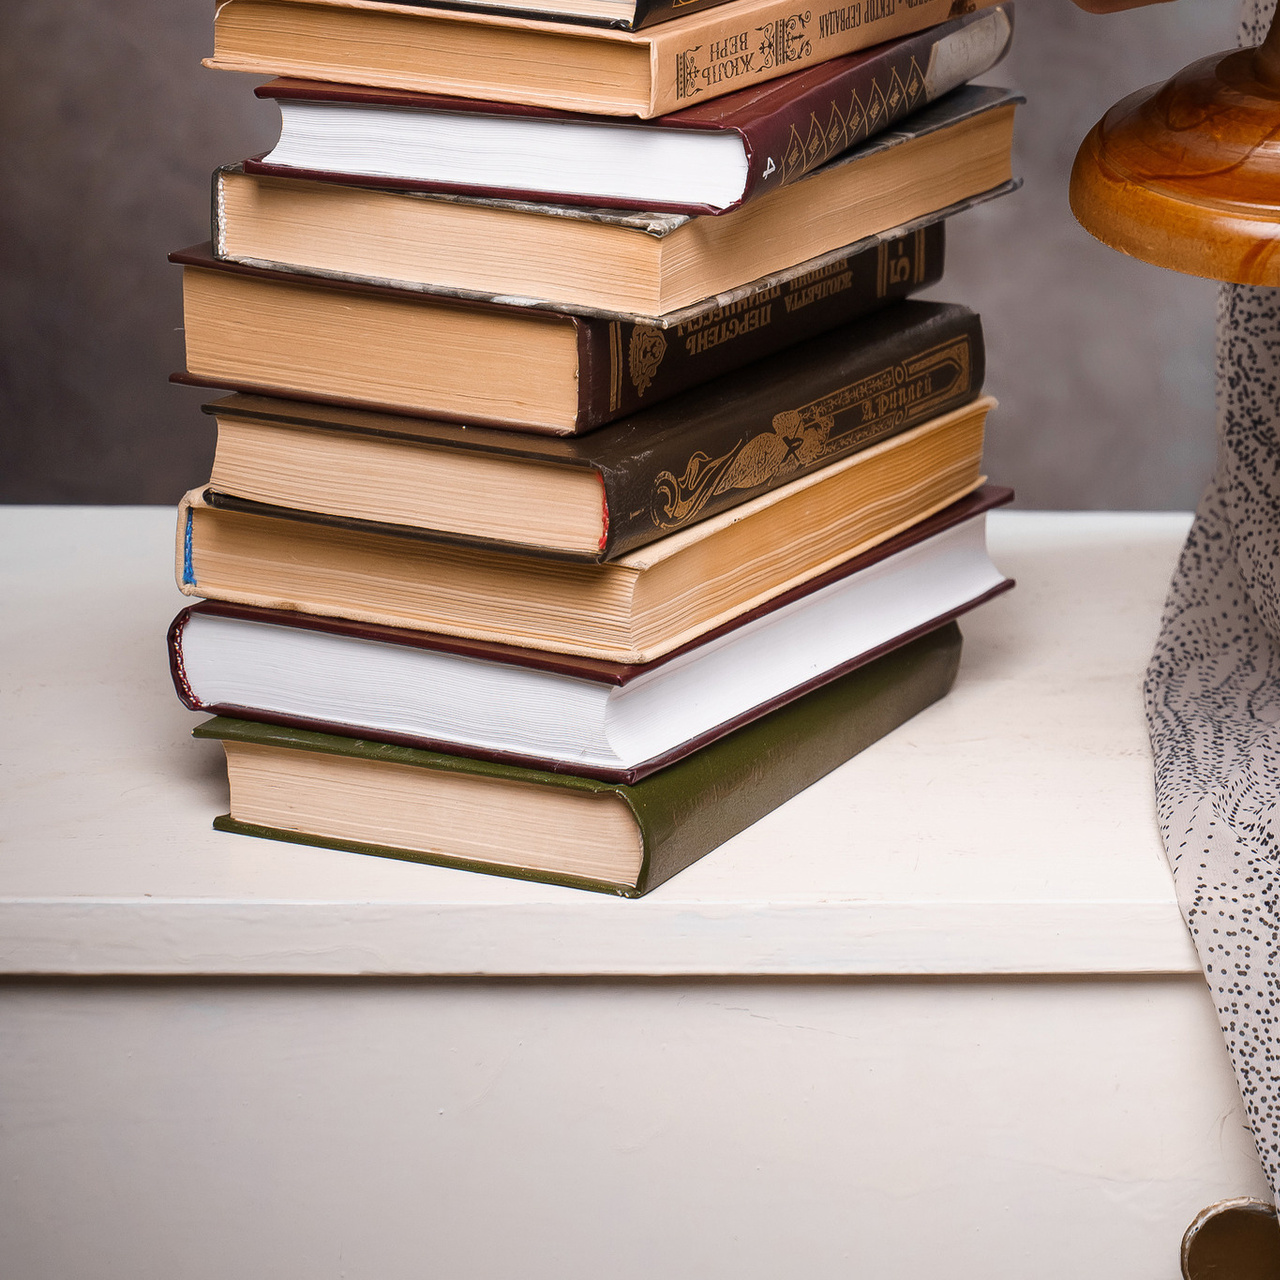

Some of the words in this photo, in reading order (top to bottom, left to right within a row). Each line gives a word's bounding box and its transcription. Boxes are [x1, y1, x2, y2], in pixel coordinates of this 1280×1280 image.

[818, 1, 862, 40] СЕРВАДАК
[708, 31, 750, 63] ВЕРН
[700, 52, 756, 87] ЖЮЛЬ
[783, 265, 853, 308] ЖЮЛЬЕТТА
[685, 303, 772, 356] ПЕРСТЕНЬ
